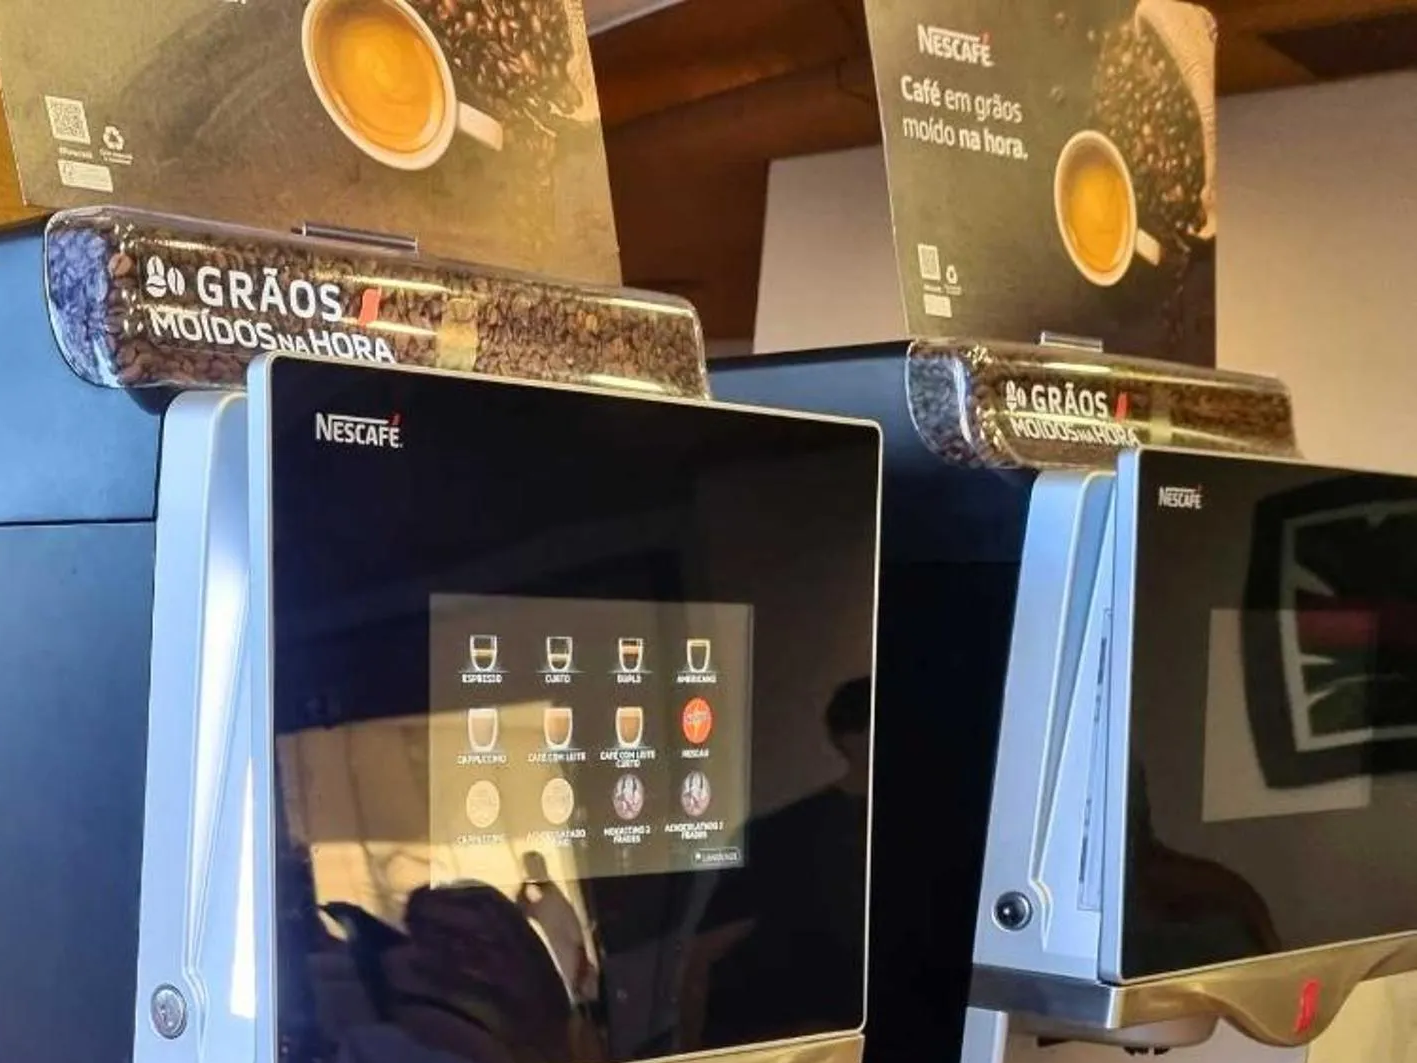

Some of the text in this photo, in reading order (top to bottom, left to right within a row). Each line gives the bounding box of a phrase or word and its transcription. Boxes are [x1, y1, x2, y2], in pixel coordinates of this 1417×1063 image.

[917, 23, 994, 67] NESCAFÉ
[900, 75, 1023, 123] Café em grãos
[902, 116, 1029, 161] moído na hora.
[197, 266, 342, 322] GRÃOS
[1031, 382, 1108, 418] GRÃOS
[316, 412, 403, 448] NESCAFÉ
